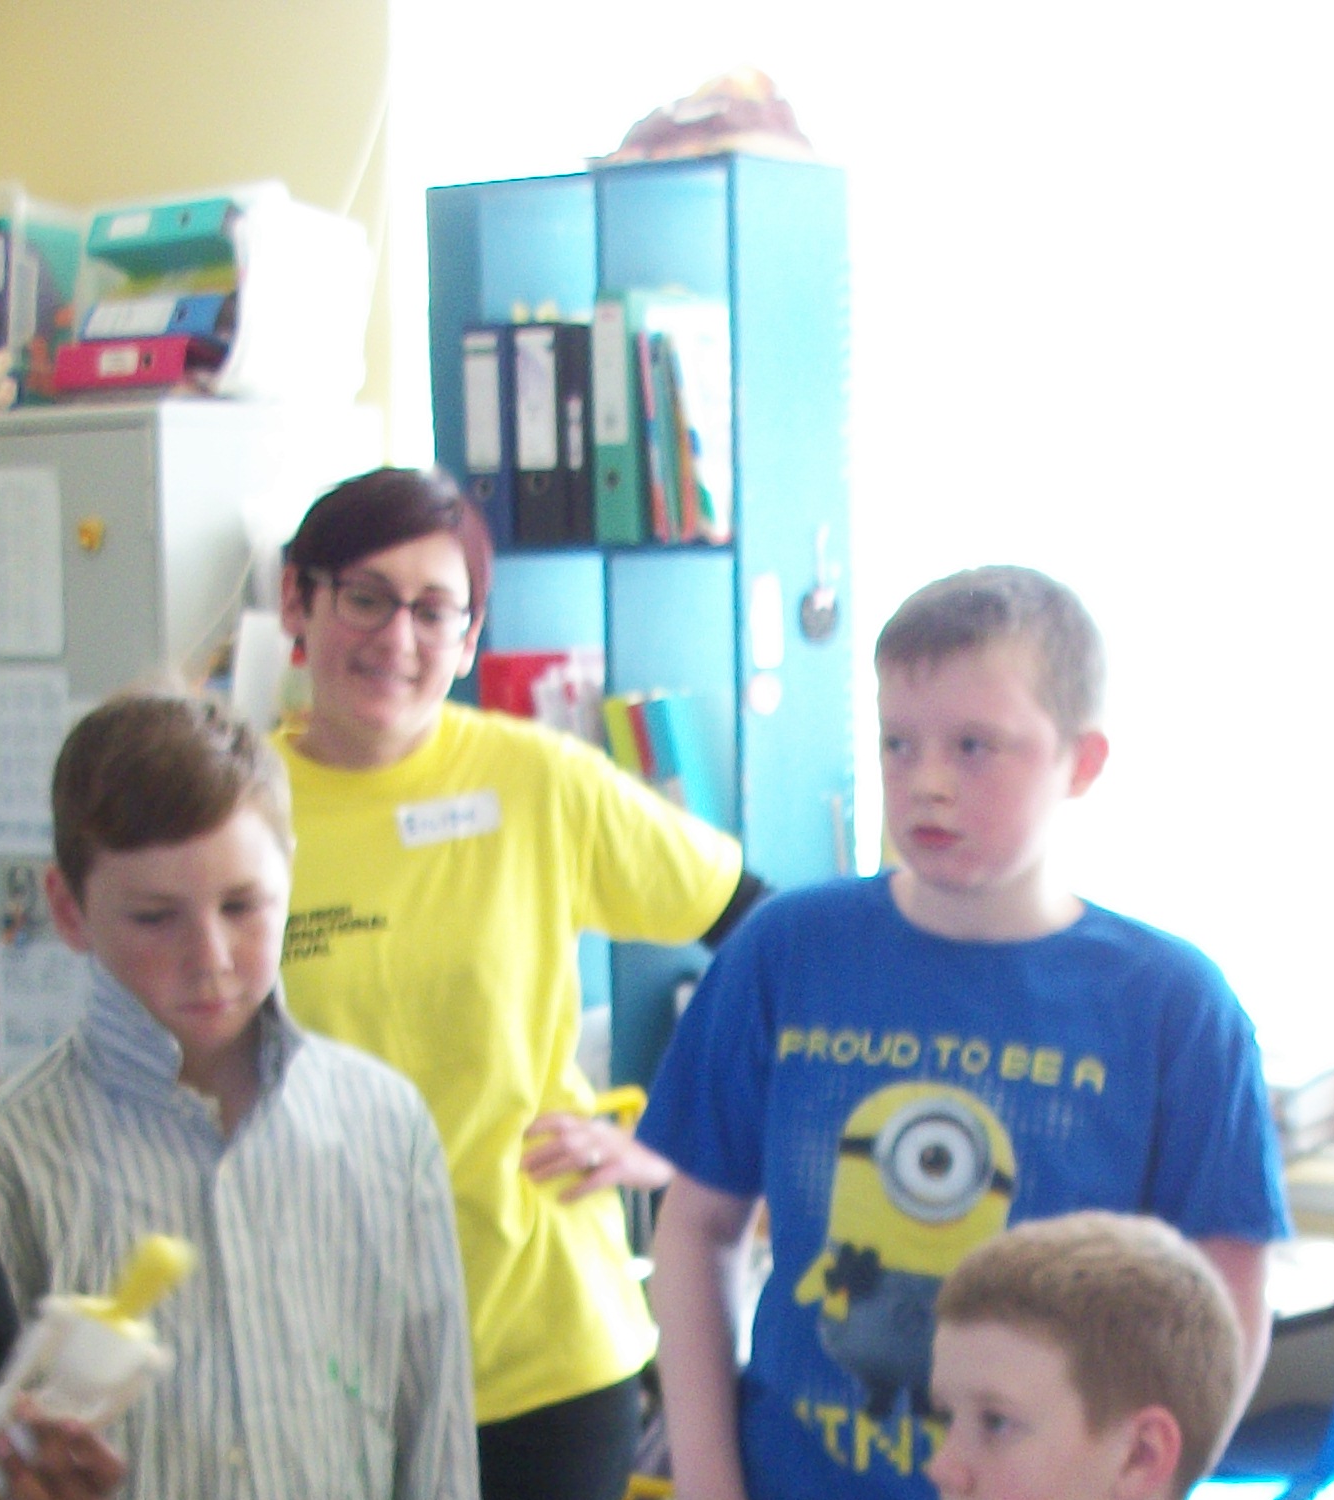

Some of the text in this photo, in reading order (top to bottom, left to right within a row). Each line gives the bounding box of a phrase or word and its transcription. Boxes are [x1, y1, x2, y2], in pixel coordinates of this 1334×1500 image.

[779, 1029, 1105, 1096] PROUD TO BE A
